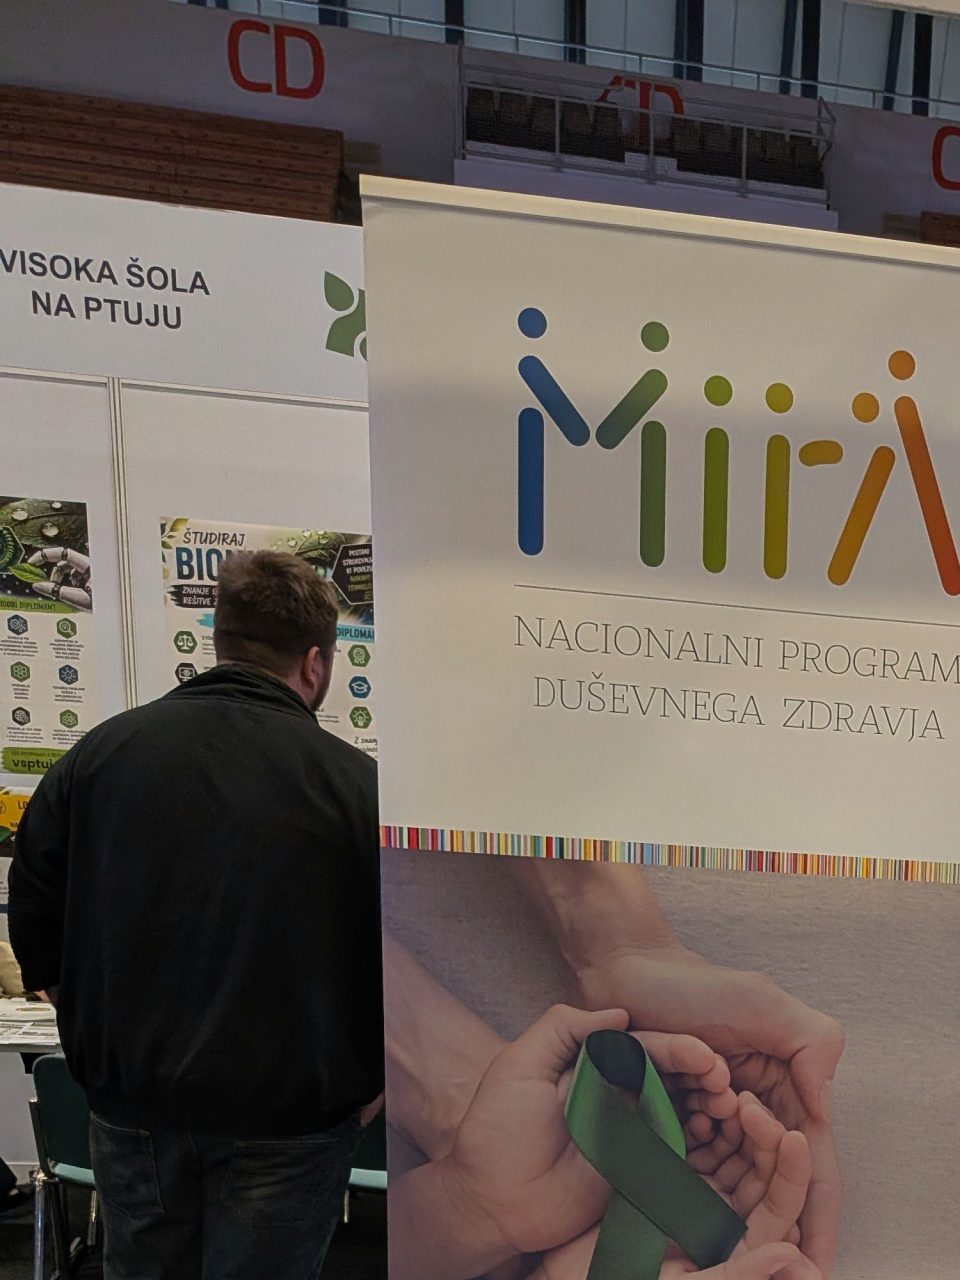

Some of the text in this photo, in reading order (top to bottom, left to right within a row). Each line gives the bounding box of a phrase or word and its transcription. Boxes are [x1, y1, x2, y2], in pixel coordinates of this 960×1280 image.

[227, 19, 325, 100] CD
[0, 249, 210, 296] VISOKA ŠOLA
[31, 290, 182, 330] NA PTUJU
[183, 528, 246, 546] ŠTUDIRAJ
[182, 587, 210, 595] ZNANJE
[183, 596, 211, 605] REŠITVE
[513, 615, 763, 668] NACIONALNI
[534, 671, 945, 742] DUŠEVNEGA ZDRAVJA
